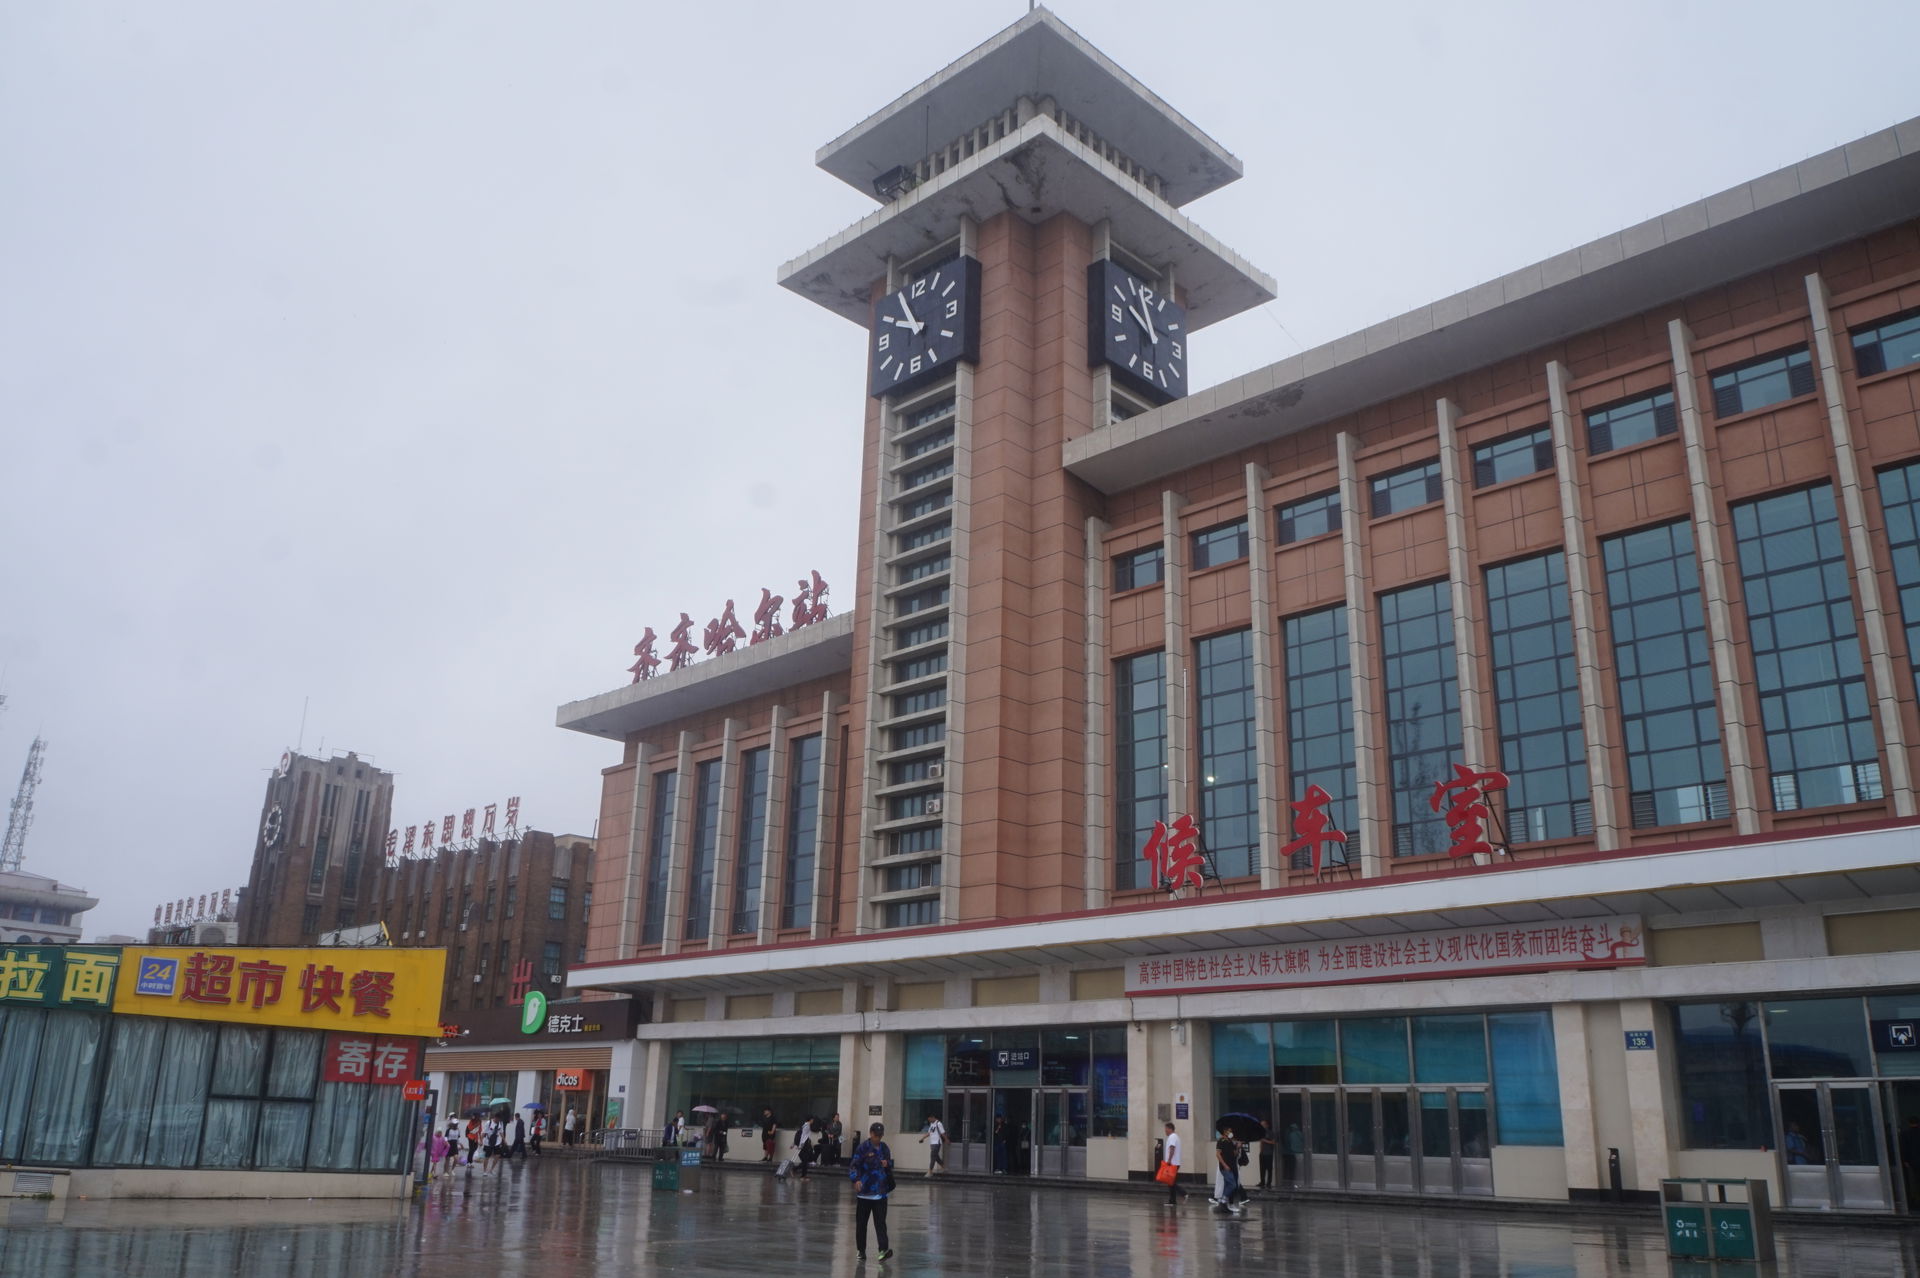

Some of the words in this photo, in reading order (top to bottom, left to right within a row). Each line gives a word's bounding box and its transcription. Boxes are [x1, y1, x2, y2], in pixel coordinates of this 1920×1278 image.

[911, 278, 927, 299] 12
[945, 299, 958, 319] 3
[1111, 303, 1122, 324] 9
[878, 333, 890, 352] 9
[1171, 341, 1182, 360] 3
[910, 355, 922, 375] 6
[1143, 361, 1154, 381] 6
[627, 569, 828, 684] 齐齐哈尔站
[384, 796, 520, 857] 毛泽东思想万岁
[1143, 763, 1510, 890] 候车室
[1138, 948, 1310, 985] 高举中国特色社会主义伟大旗帜
[1317, 922, 1613, 972] 为全面建设社会主义现代化国家而团结奋斗
[0, 950, 119, 1005] 拉面
[143, 963, 173, 980] 24
[179, 952, 288, 1009] 超市
[299, 963, 395, 1018] 快餐
[547, 1013, 585, 1034] 德克士
[1632, 1037, 1646, 1046] 136
[336, 1041, 408, 1079] 寄存
[556, 1073, 578, 1086] dicos
